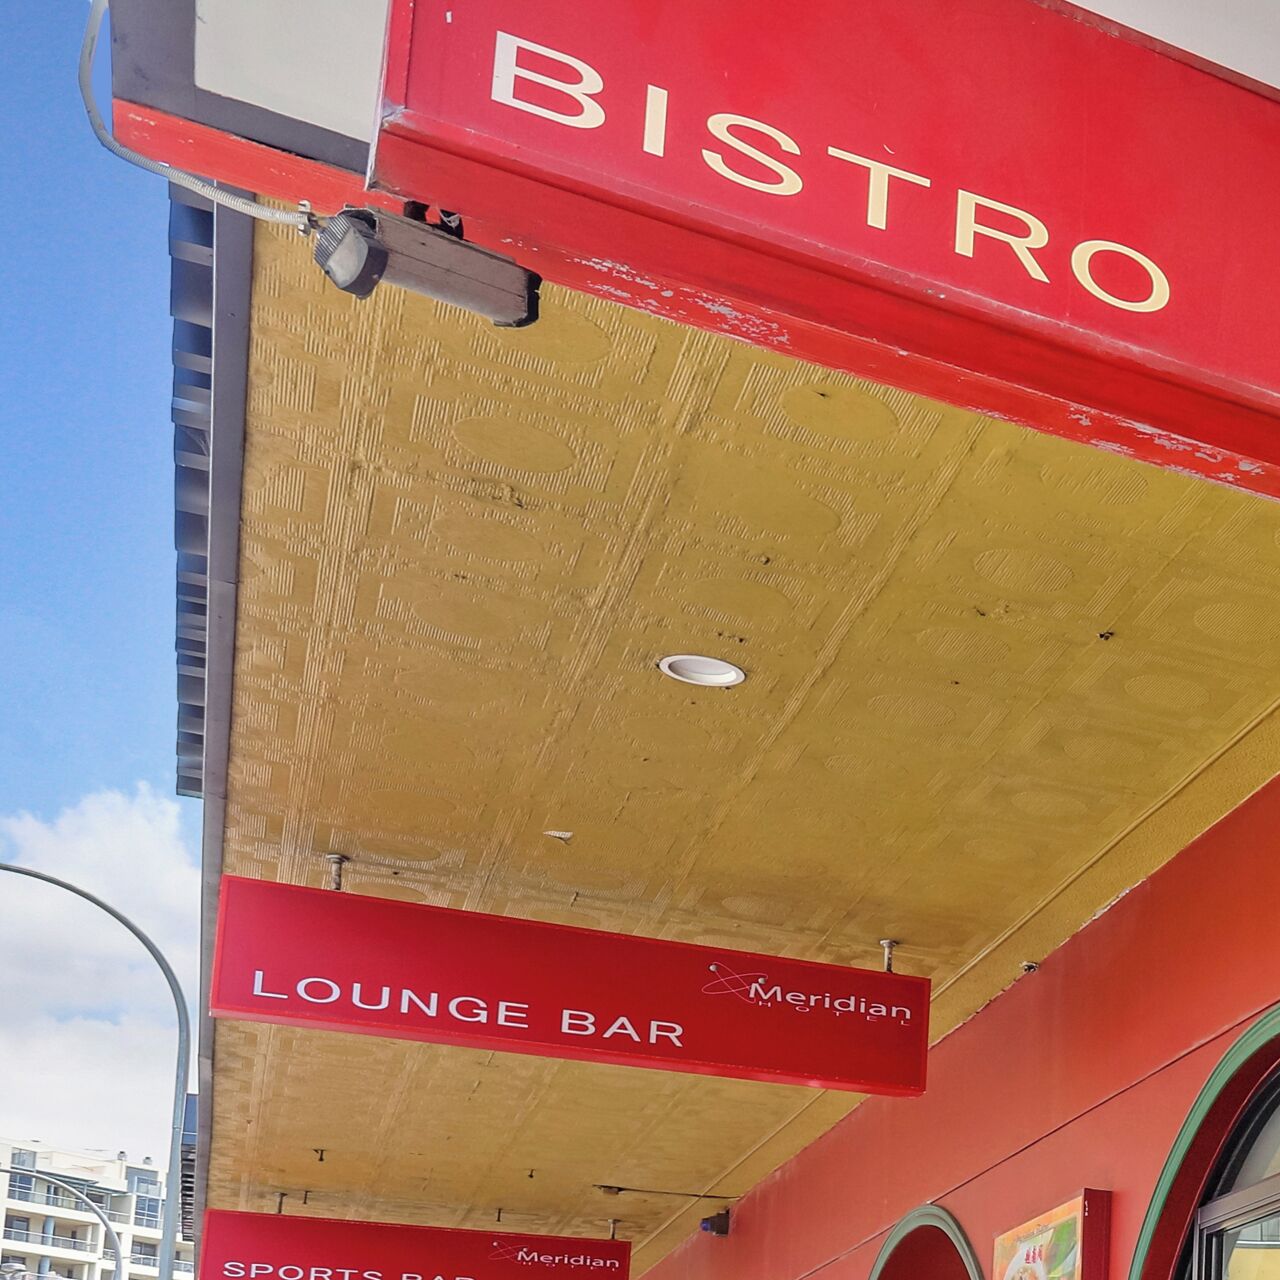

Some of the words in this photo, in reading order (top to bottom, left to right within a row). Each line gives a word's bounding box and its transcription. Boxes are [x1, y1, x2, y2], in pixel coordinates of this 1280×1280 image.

[491, 30, 1171, 313] BISTRO
[252, 969, 530, 1030] LOUNGE
[560, 1008, 685, 1048] BAR
[748, 980, 911, 1020] Meridian
[757, 999, 911, 1028] HOTEL
[516, 1249, 620, 1269] Meridian
